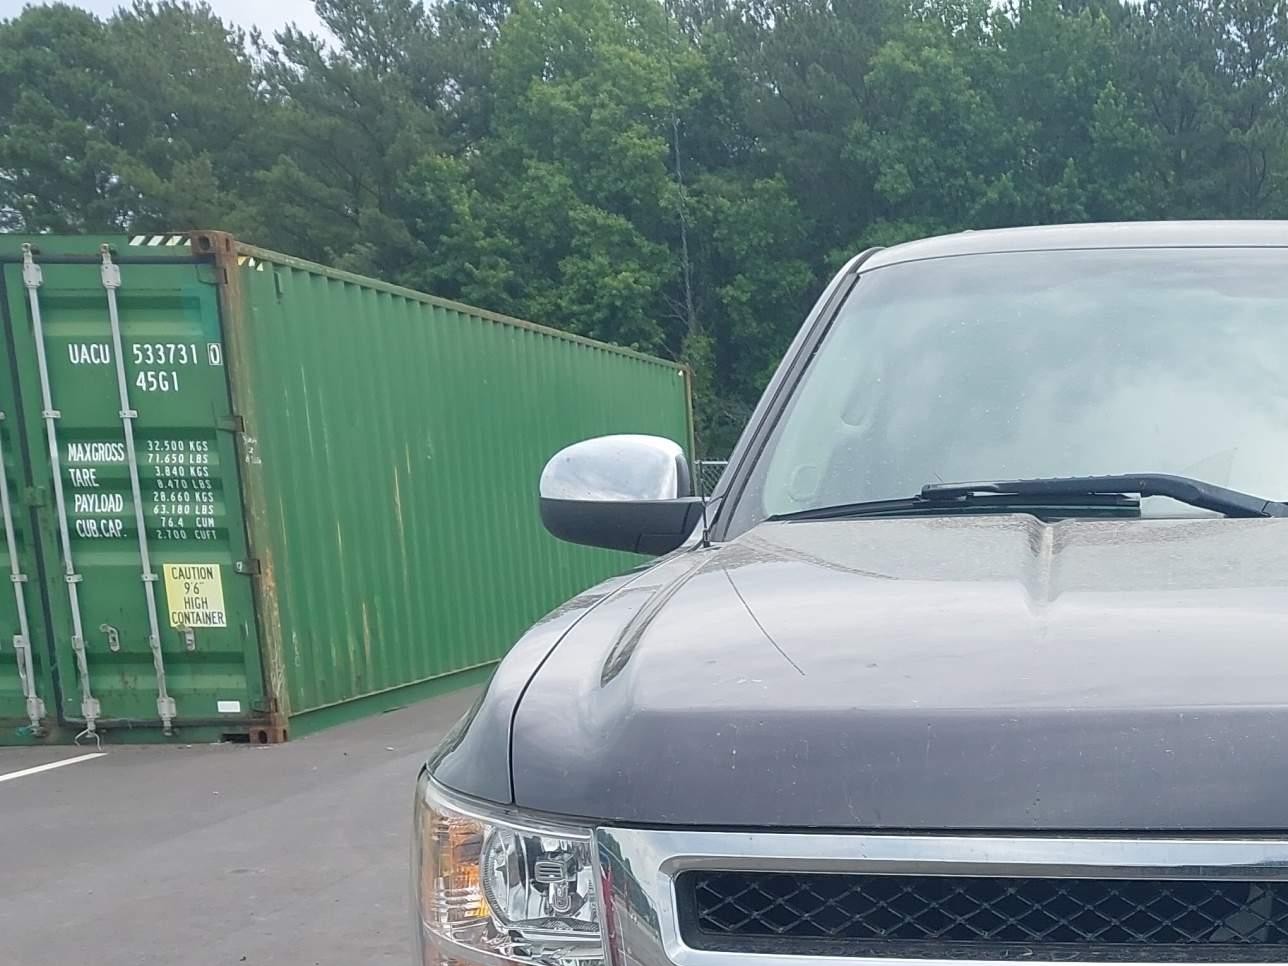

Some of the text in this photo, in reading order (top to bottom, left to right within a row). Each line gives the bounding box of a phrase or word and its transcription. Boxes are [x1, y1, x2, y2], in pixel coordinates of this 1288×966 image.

[68, 343, 222, 365] UACU 533731 0
[135, 371, 179, 391] 45G1
[146, 440, 209, 451] 32.500 KGS
[147, 453, 209, 464] 71.650 LBS
[68, 468, 100, 487] TARE
[189, 466, 209, 477] KGS
[192, 479, 212, 489] LBS
[195, 491, 214, 502] KGS
[74, 493, 124, 513] PAYLOAD
[195, 504, 214, 515] LBS
[195, 517, 215, 528] CUM
[171, 566, 214, 580] CAUTION
[184, 596, 209, 610] HIGH
[171, 611, 225, 625] CONTAINER
